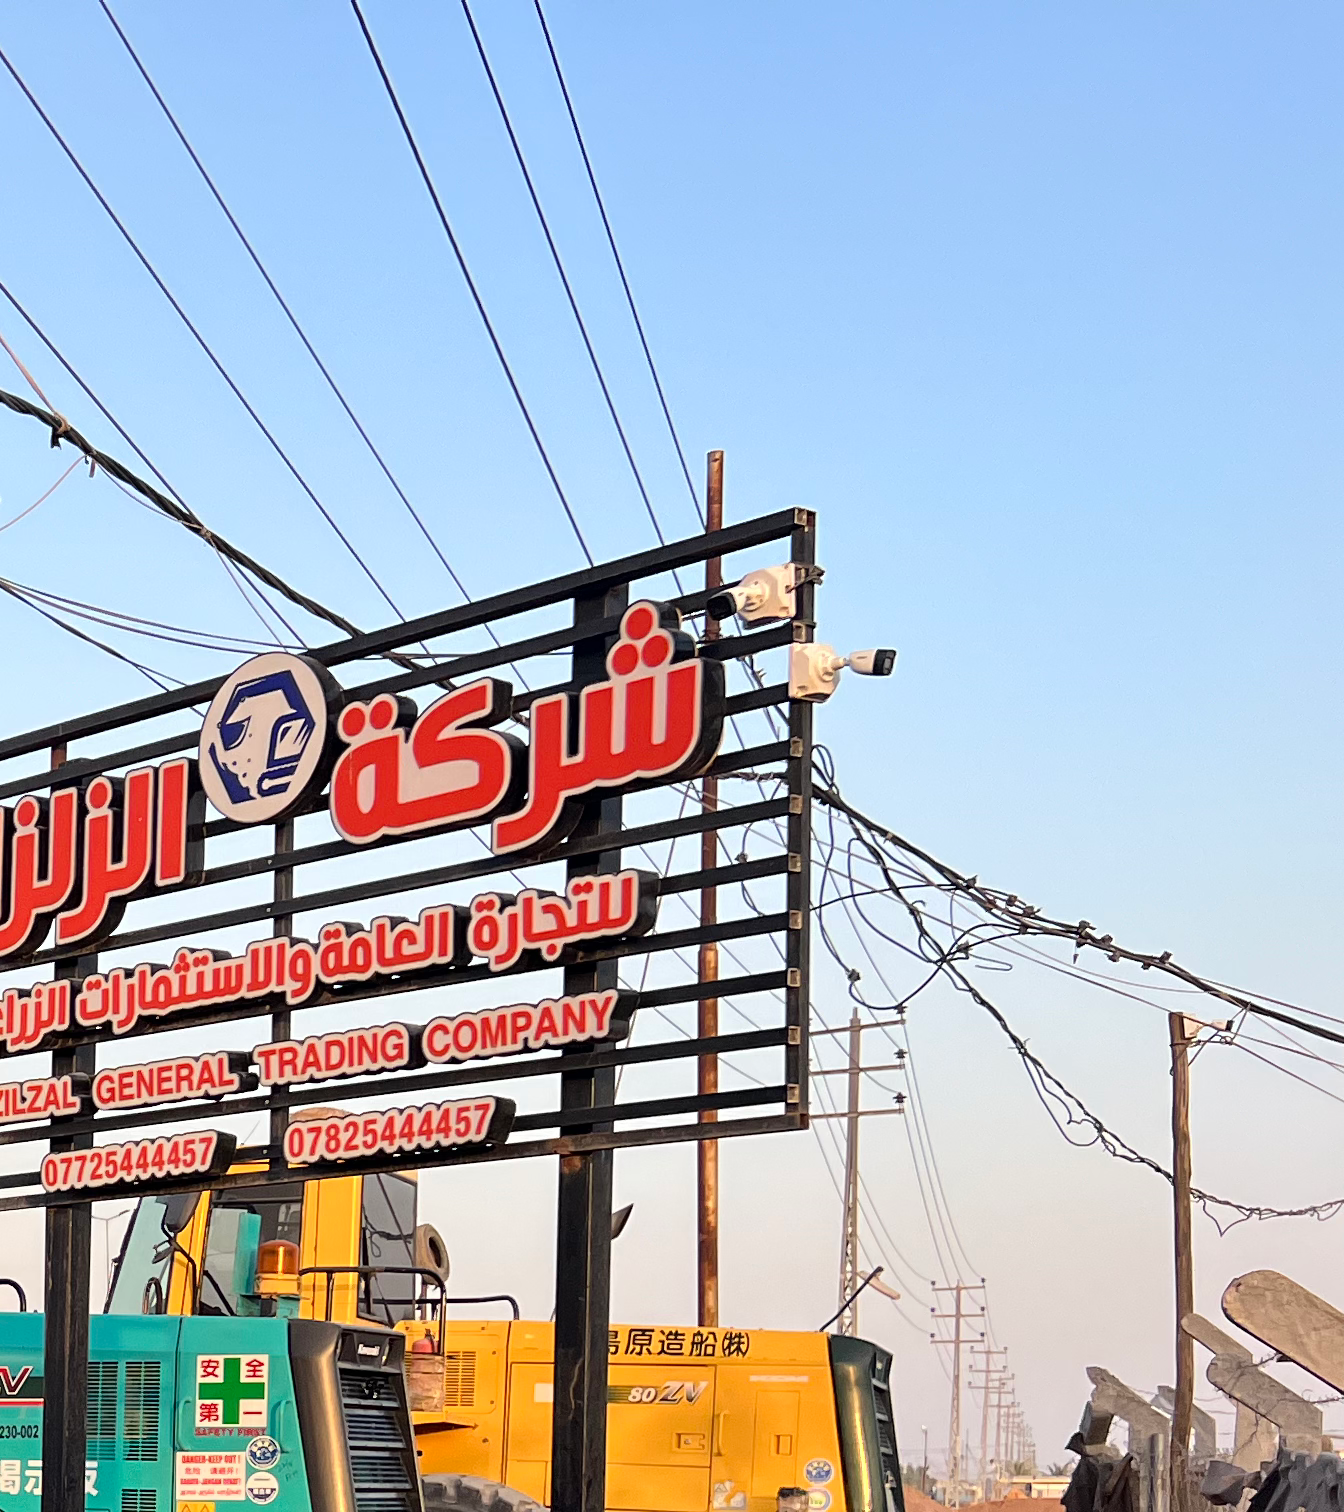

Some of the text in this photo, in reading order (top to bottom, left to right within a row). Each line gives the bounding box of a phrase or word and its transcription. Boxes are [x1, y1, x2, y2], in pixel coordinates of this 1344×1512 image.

[331, 604, 700, 851] شركة
[318, 909, 451, 980] العامة
[471, 874, 635, 967] للتجارة
[78, 940, 314, 1032] والاستثمارات
[95, 1054, 236, 1106] GENERAL
[255, 1027, 406, 1081] TRADING
[425, 993, 616, 1058] COMPANY
[42, 1102, 493, 1189] 07725444457 07825444457
